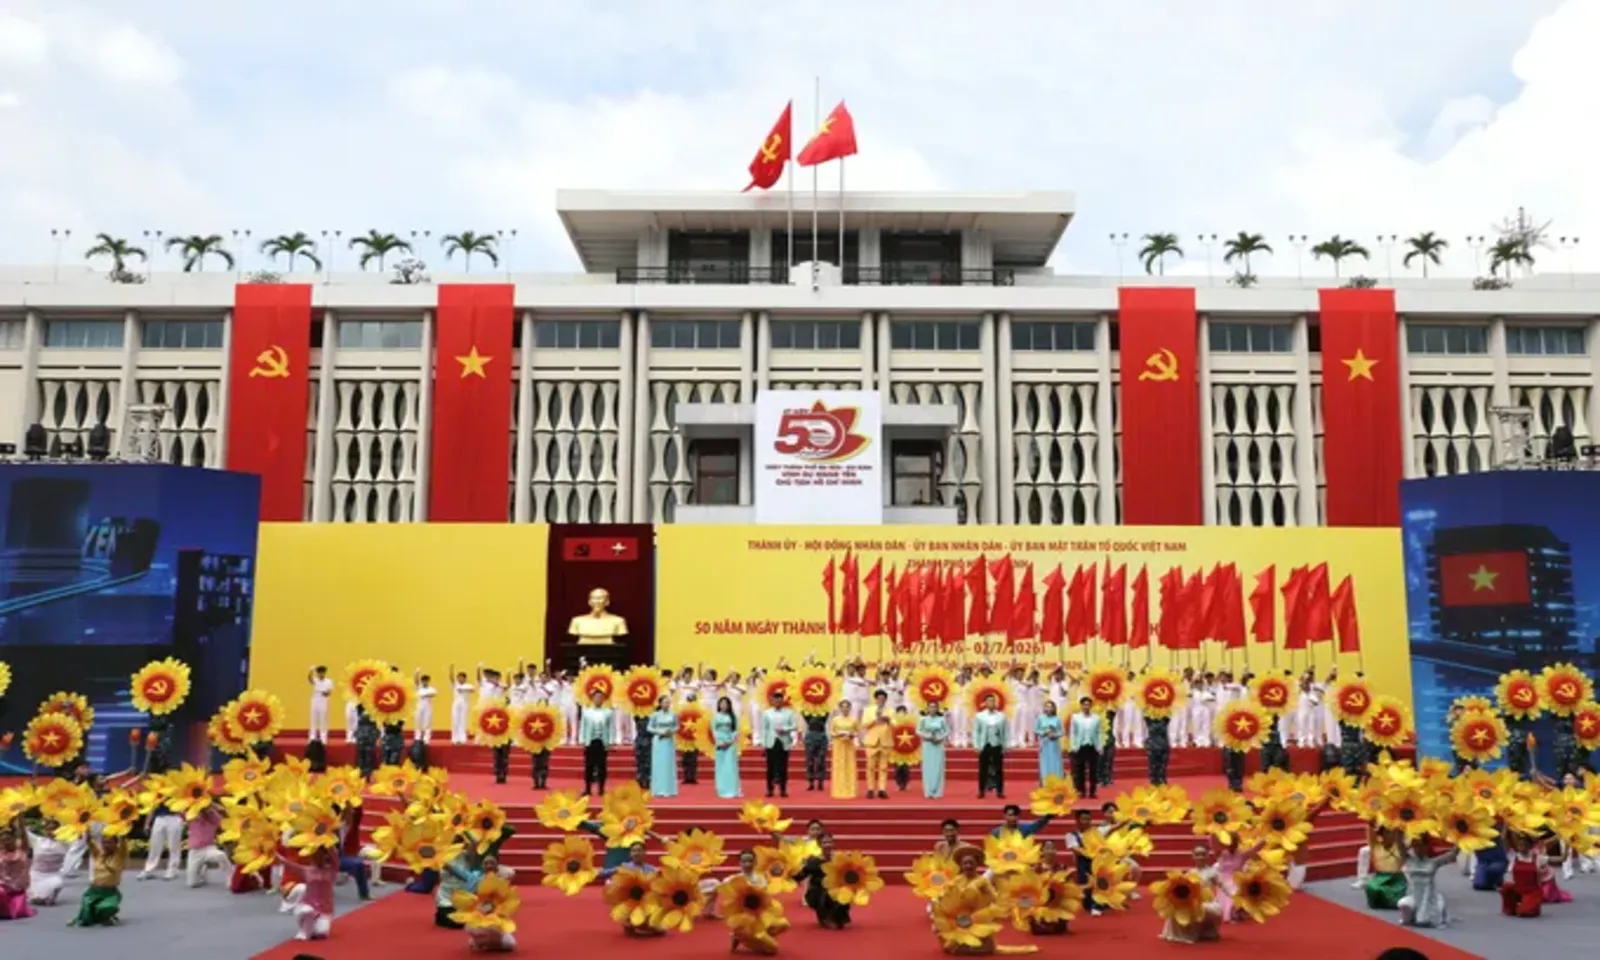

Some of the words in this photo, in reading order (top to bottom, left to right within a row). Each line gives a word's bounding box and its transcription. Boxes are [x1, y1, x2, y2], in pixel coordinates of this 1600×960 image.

[748, 538, 782, 550] THÀNH
[804, 539, 822, 552] HỘI
[854, 539, 883, 550] NHÂN
[884, 539, 907, 550] DÂN
[929, 541, 949, 551] BAN
[950, 539, 980, 551] NHÂN
[981, 539, 1003, 551] DÂN
[1026, 541, 1046, 551] BAN
[1113, 538, 1140, 552] QUỐC
[1141, 539, 1162, 553] VIỆT
[1164, 541, 1187, 551] NAM
[695, 621, 711, 634] 50
[713, 618, 743, 634] NĂM
[745, 619, 779, 634] NGÀY
[782, 619, 826, 634] THÀNH
